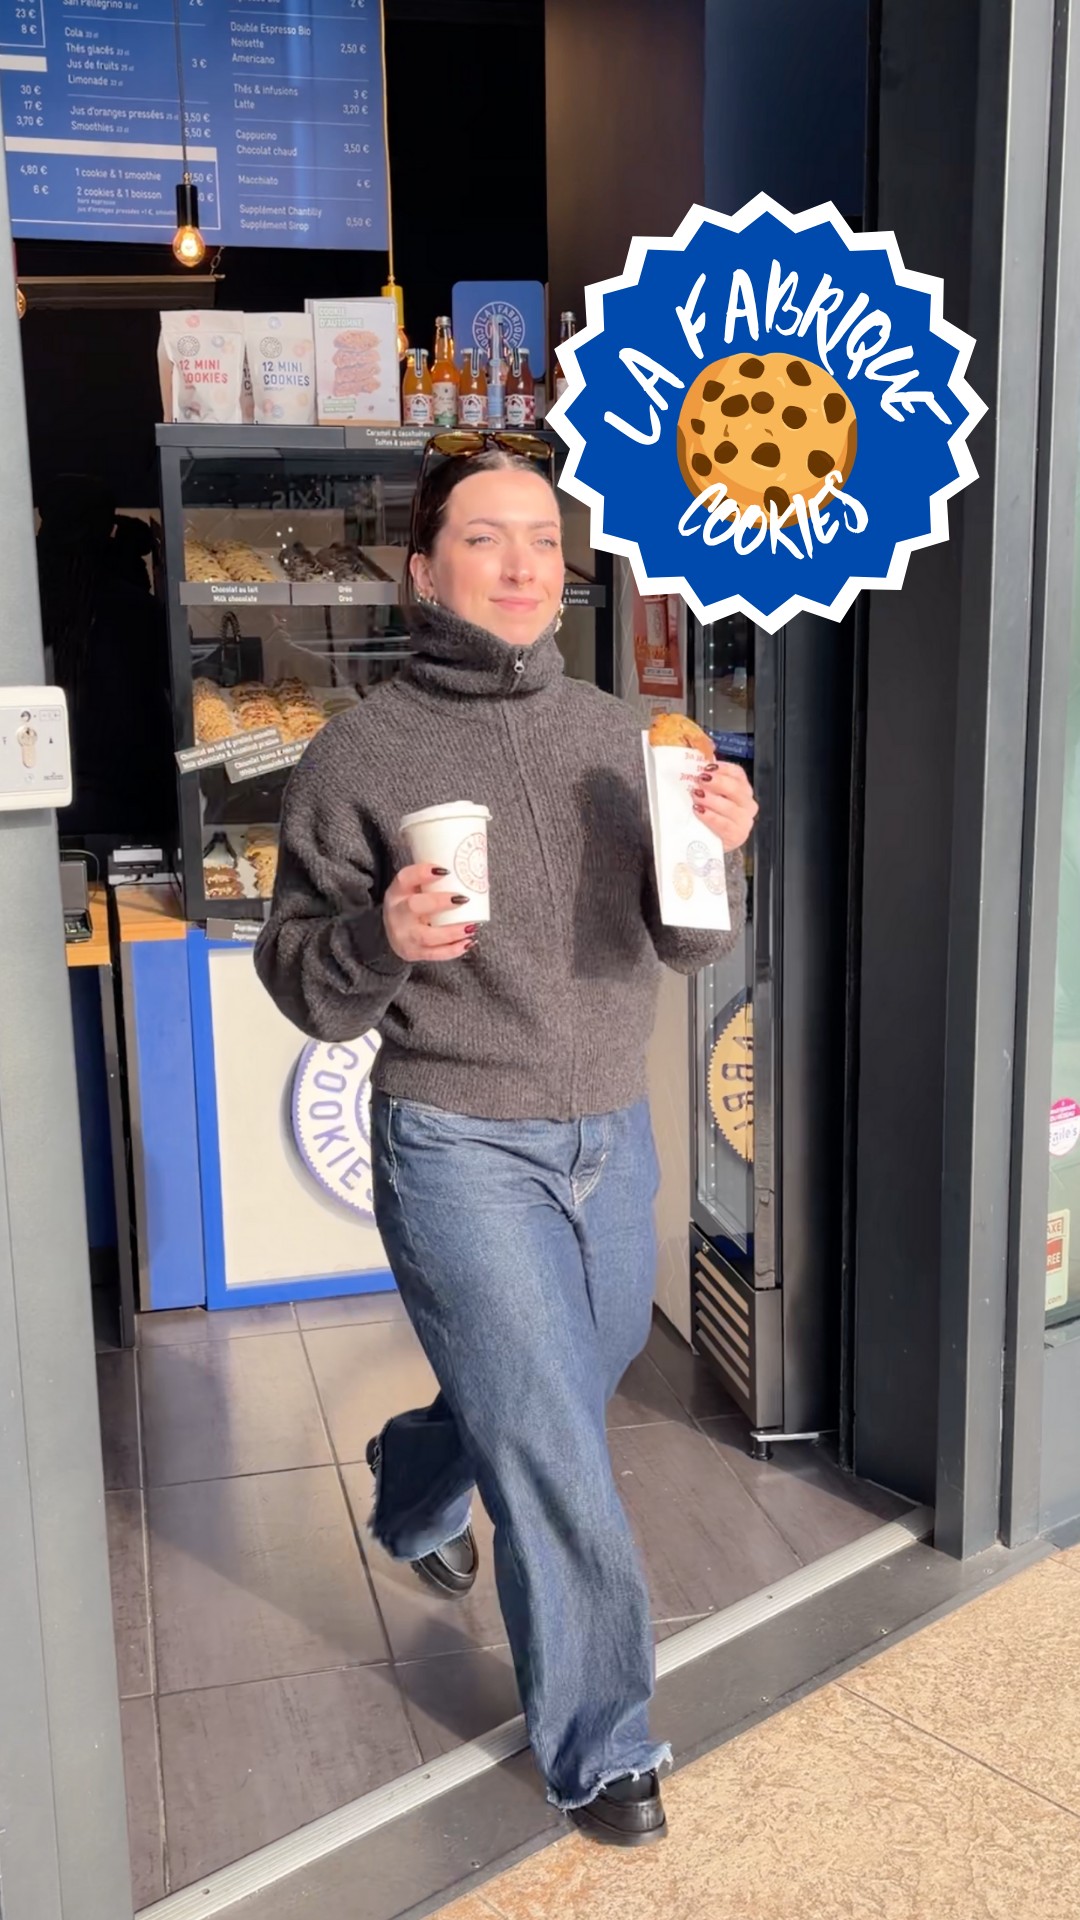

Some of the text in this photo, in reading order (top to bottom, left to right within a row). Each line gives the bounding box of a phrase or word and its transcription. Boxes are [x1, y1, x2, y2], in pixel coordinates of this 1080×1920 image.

[80, 0, 123, 10] Pellegrino
[351, 0, 365, 8] 2 €
[15, 8, 36, 19] 23 €
[21, 23, 37, 35] 8 €
[64, 27, 84, 37] Cola
[230, 21, 311, 36] Double Espresso Bio
[231, 37, 264, 48] Noisette
[65, 42, 86, 53] Thés
[87, 44, 114, 56] glacés
[340, 43, 366, 54] 2,50 €
[192, 58, 207, 69] 3 €
[232, 53, 275, 64] Americano
[66, 59, 82, 69] Jus
[84, 60, 94, 70] de
[96, 60, 119, 71] fruits
[68, 74, 108, 86] Limonade
[20, 84, 42, 95] 30 €
[234, 83, 298, 96] Thés & infusions
[353, 89, 368, 100] 3 €
[24, 100, 43, 111] 17 €
[234, 98, 255, 109] Latte
[70, 105, 85, 115] Jus
[87, 106, 127, 119] d'oranges
[128, 109, 165, 120] pressées
[342, 104, 368, 115] 3,20 €
[16, 115, 44, 127] 3,70 €
[184, 112, 210, 123] 3,50 €
[71, 121, 114, 133] Smoothies
[184, 128, 211, 139] 5,50 €
[235, 129, 277, 141] Cappucino
[236, 144, 297, 157] Chocolat chaud
[343, 143, 370, 154] 3,50 €
[20, 164, 48, 175] 4,80 €
[75, 168, 161, 180] 1 cookie & 1 smoothie
[206, 173, 213, 183] €
[238, 174, 279, 185] Macchiato
[356, 179, 371, 188] 4 €
[33, 184, 49, 195] 6 €
[76, 186, 162, 199] 2 cookies & 1 boisson
[207, 192, 214, 202] €
[240, 204, 322, 218] Supplément Chantilly
[240, 218, 309, 232] Supplément Sirop
[345, 216, 372, 228] 0,50 €
[478, 304, 522, 347] LA FABRIQUE
[179, 359, 220, 370] 12 MINI
[262, 361, 303, 372] 12 MINI
[263, 374, 310, 386] COOKIES
[211, 585, 238, 593] Chocolat
[247, 585, 258, 593] lait
[1047, 1222, 1061, 1234] AXE
[1047, 1252, 1061, 1264] REE
